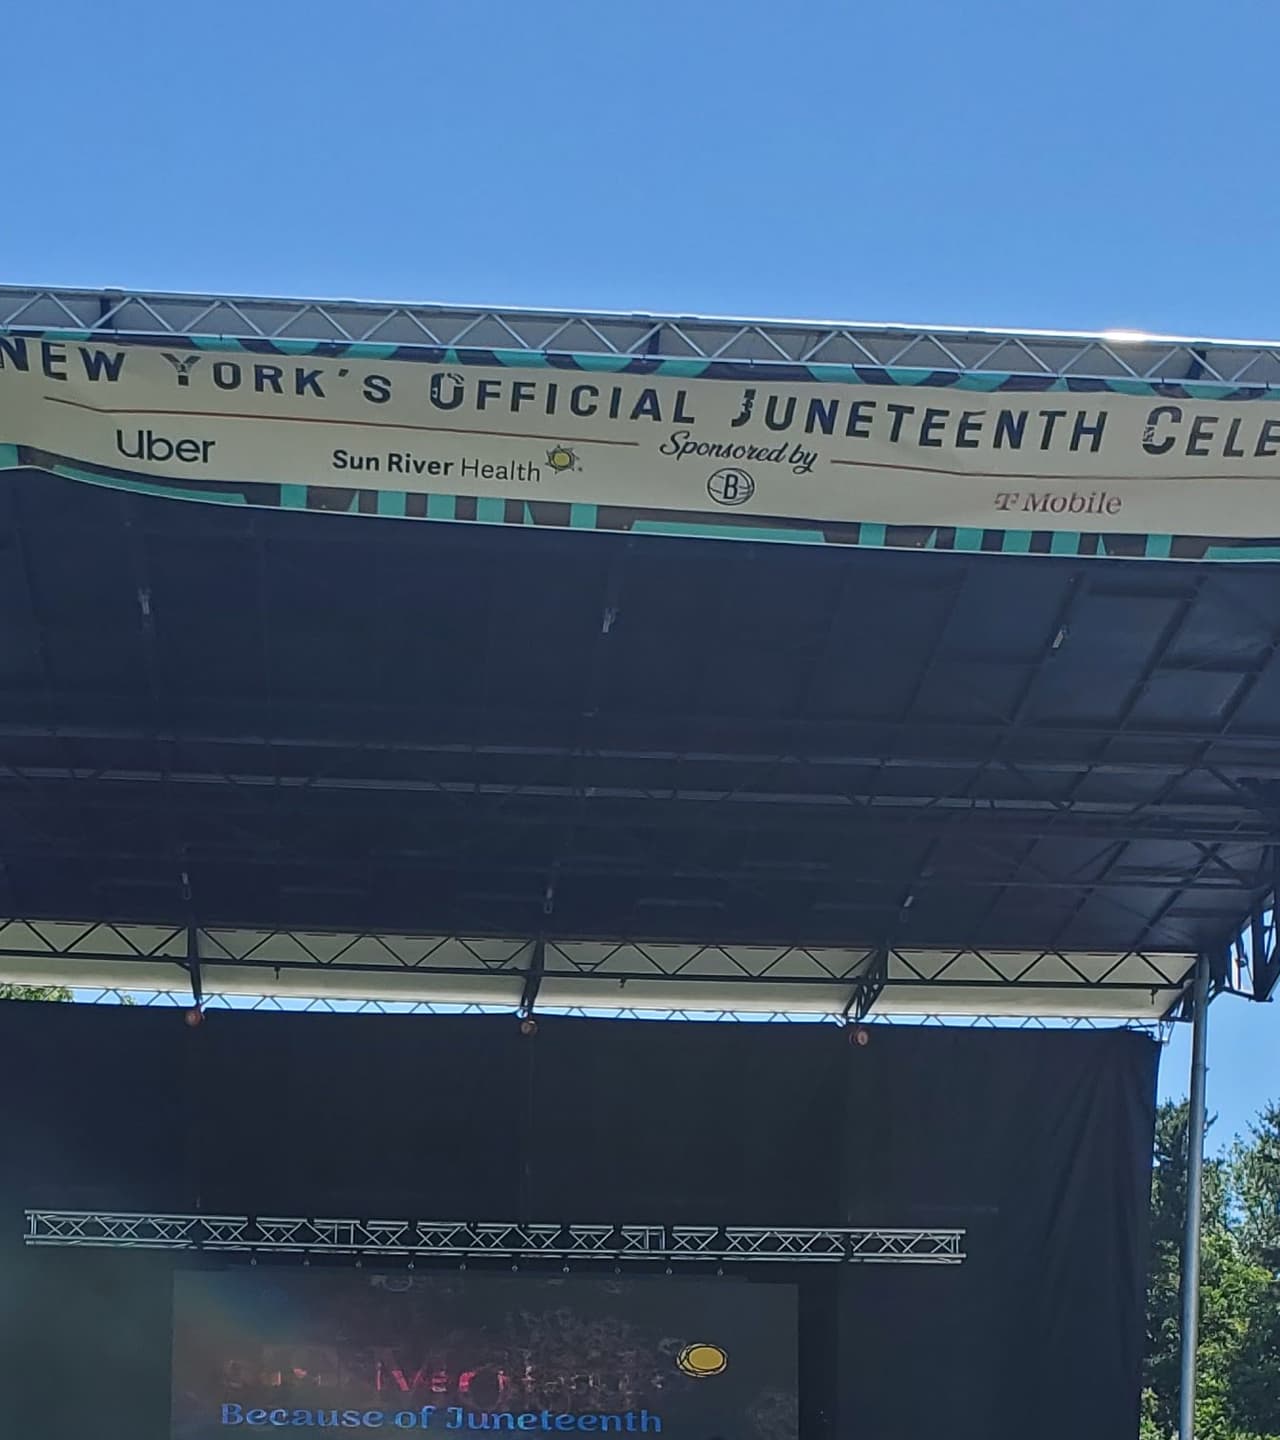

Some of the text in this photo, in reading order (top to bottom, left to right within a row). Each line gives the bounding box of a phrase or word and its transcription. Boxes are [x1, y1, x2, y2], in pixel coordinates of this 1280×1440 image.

[160, 353, 392, 404] YORK'S
[431, 373, 695, 424] OFFICIAL
[731, 389, 1107, 453] JUNETEENTH
[116, 429, 215, 463] Uber
[659, 431, 818, 474] Sponsored by
[332, 449, 540, 483] Sun River Health
[1022, 491, 1122, 515] Mobile
[221, 1402, 662, 1433] Because of Juneteenth
